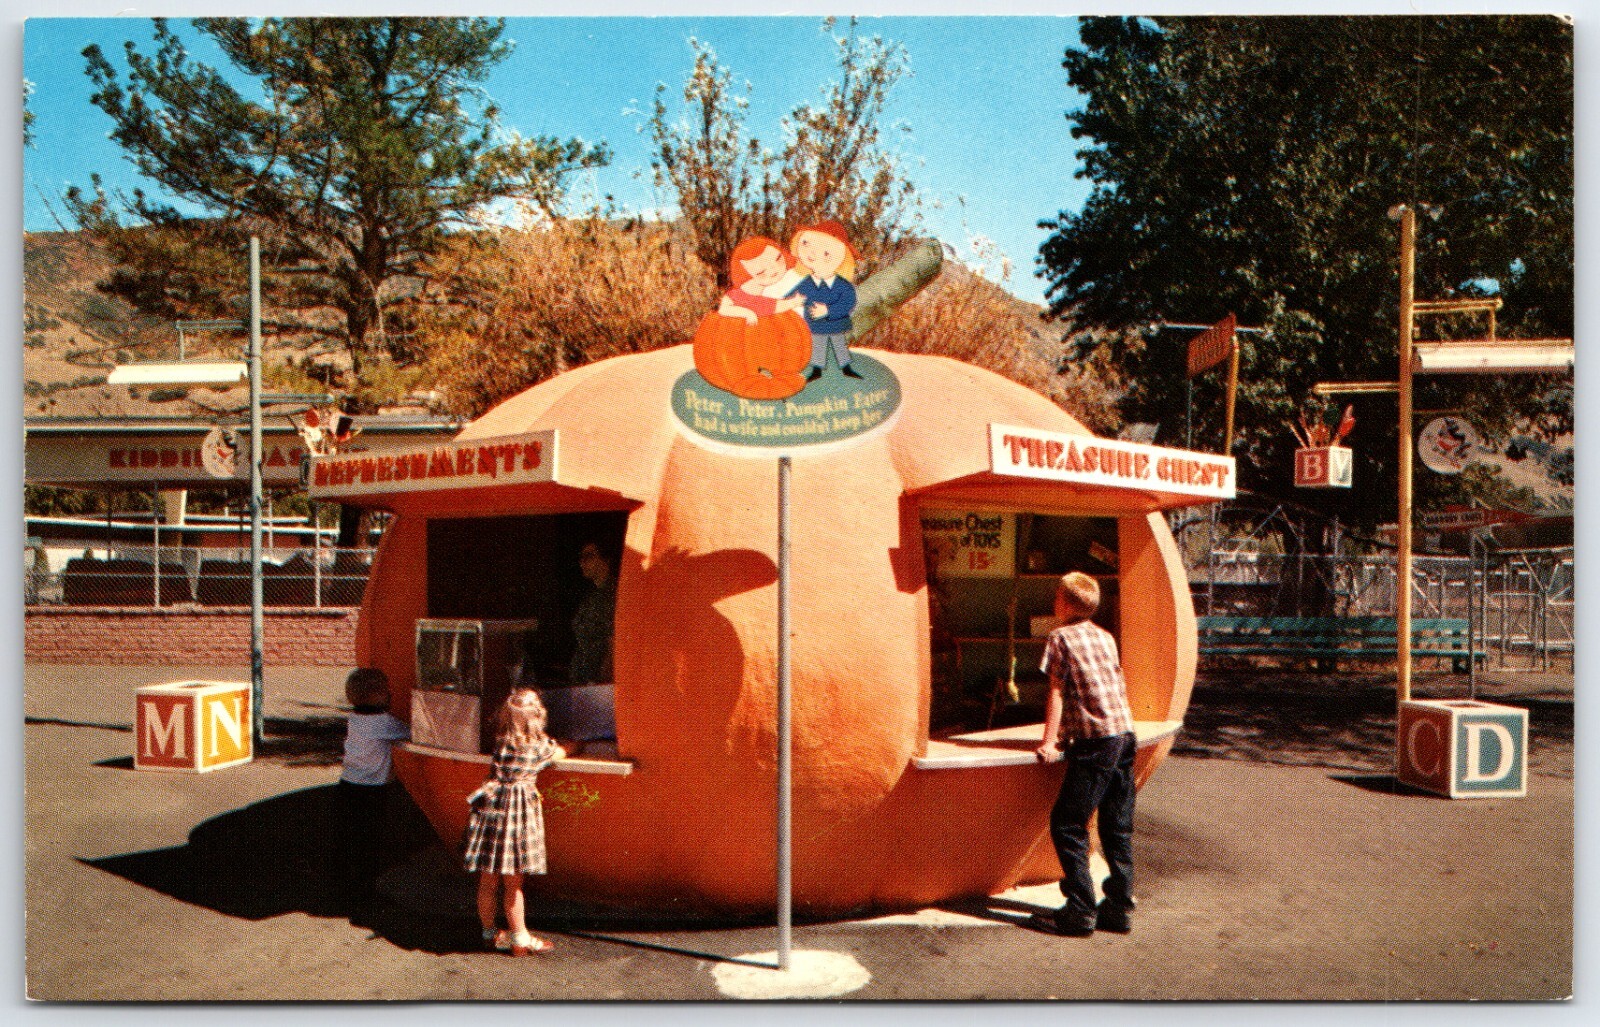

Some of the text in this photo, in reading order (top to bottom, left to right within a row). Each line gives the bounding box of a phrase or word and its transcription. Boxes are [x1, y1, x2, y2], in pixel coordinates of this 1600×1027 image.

[694, 413, 717, 431] had
[720, 421, 728, 434] a
[729, 420, 758, 436] wife
[760, 423, 780, 435] and
[831, 416, 859, 432] keep
[785, 397, 848, 418] Pumpkin
[853, 389, 889, 408] Eater
[314, 440, 542, 487] REFRESHMENTS
[1003, 434, 1229, 489] TREASURE CHEST
[1303, 454, 1322, 480] B
[966, 511, 1002, 530] Chest
[144, 702, 188, 758] M
[209, 697, 243, 757] N
[1408, 719, 1440, 775] C
[1462, 722, 1514, 782] D
